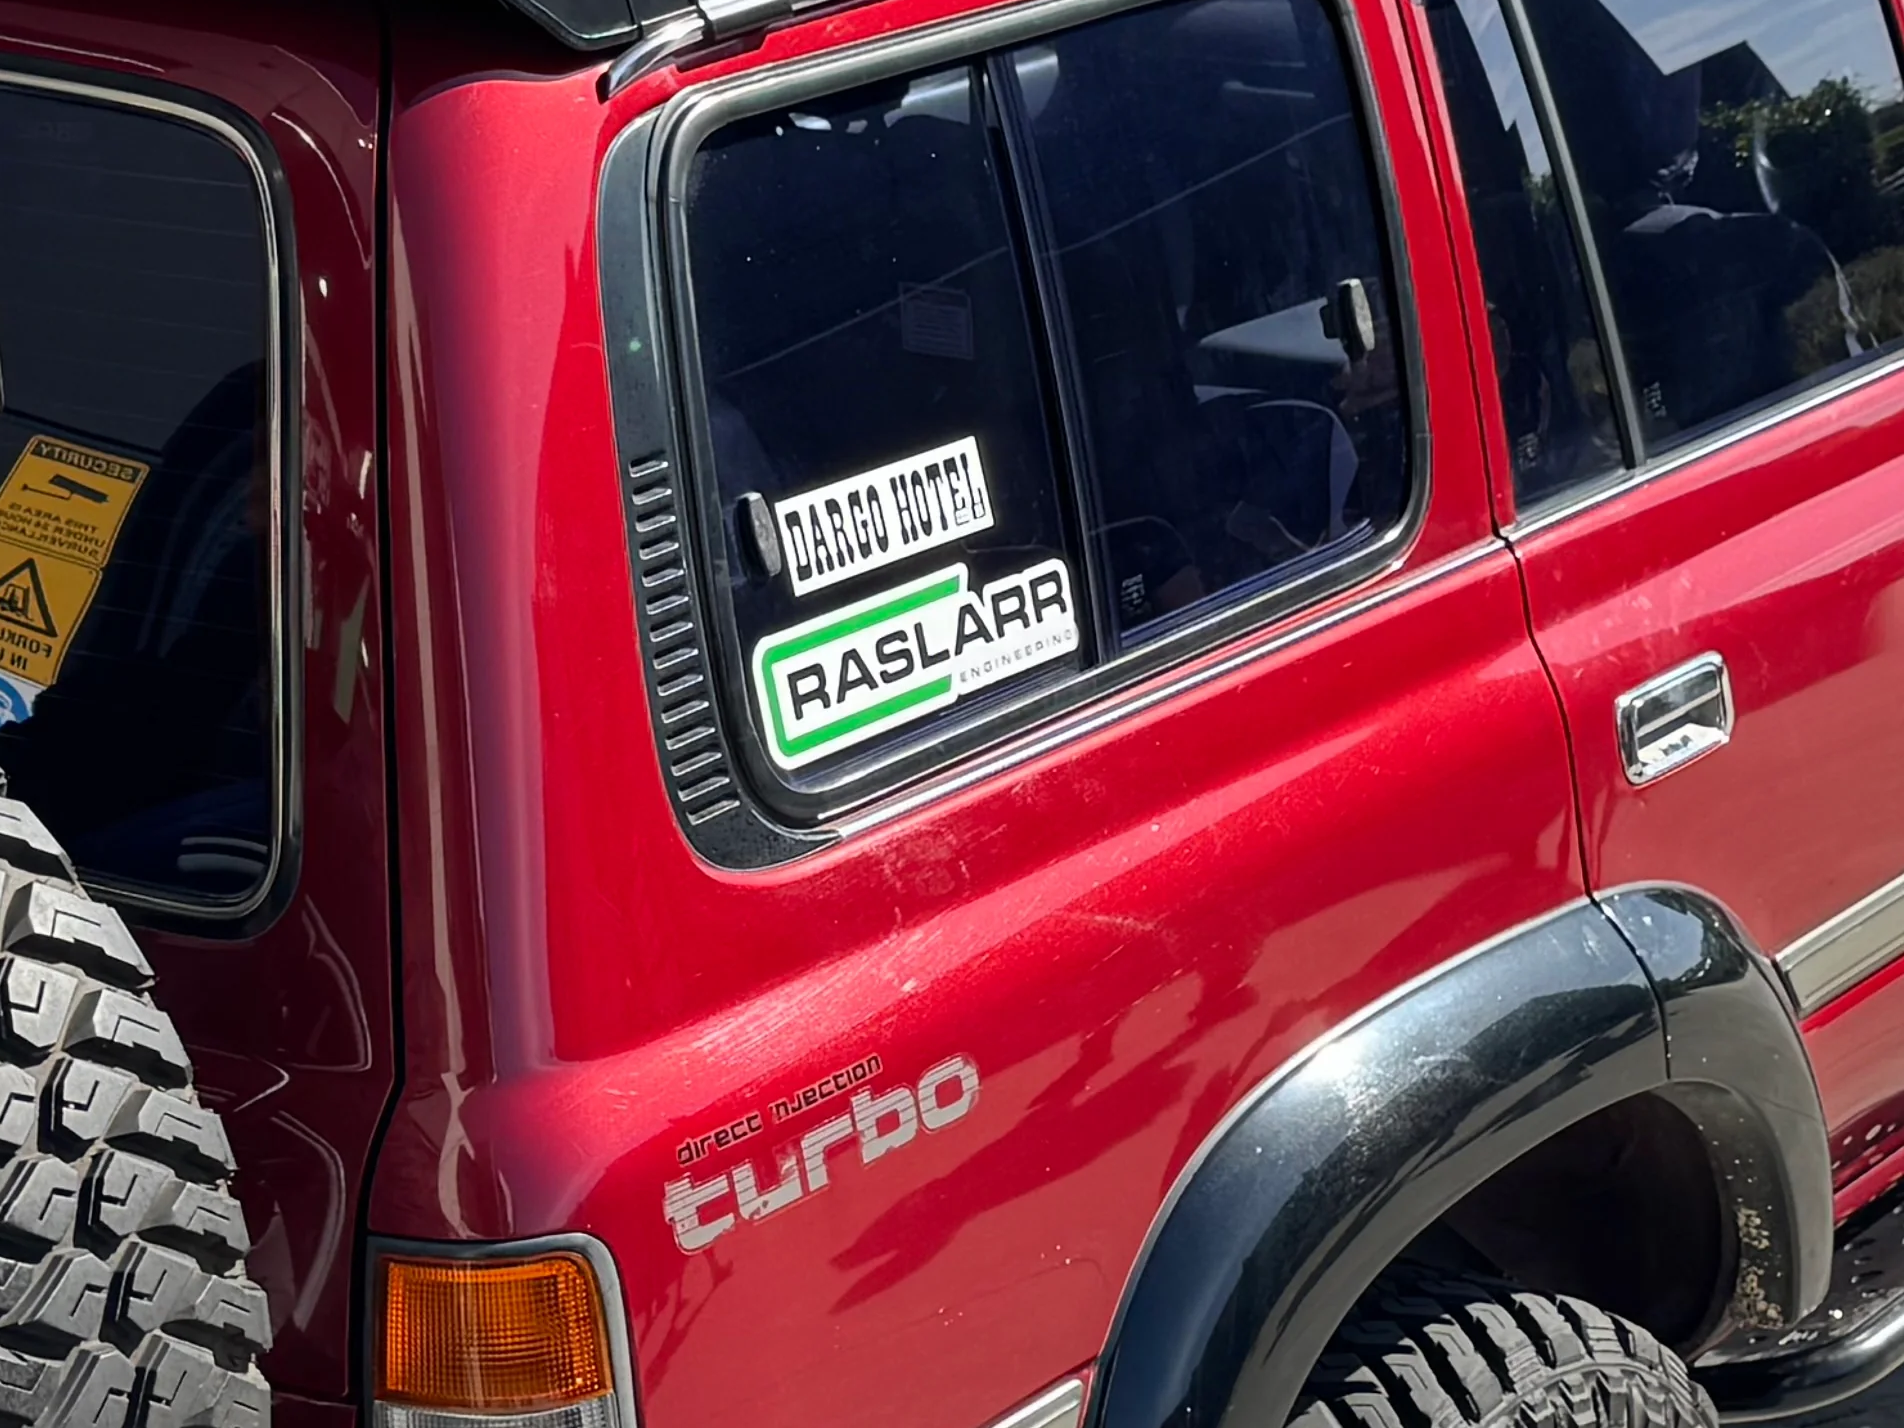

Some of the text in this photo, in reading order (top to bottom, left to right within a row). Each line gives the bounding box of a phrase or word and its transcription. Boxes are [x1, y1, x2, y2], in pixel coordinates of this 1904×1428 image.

[785, 453, 987, 582] DARGO HOTEL
[786, 568, 1069, 722] RASLARR
[959, 627, 1075, 684] ENGINEERING
[662, 1051, 982, 1256] turbo
